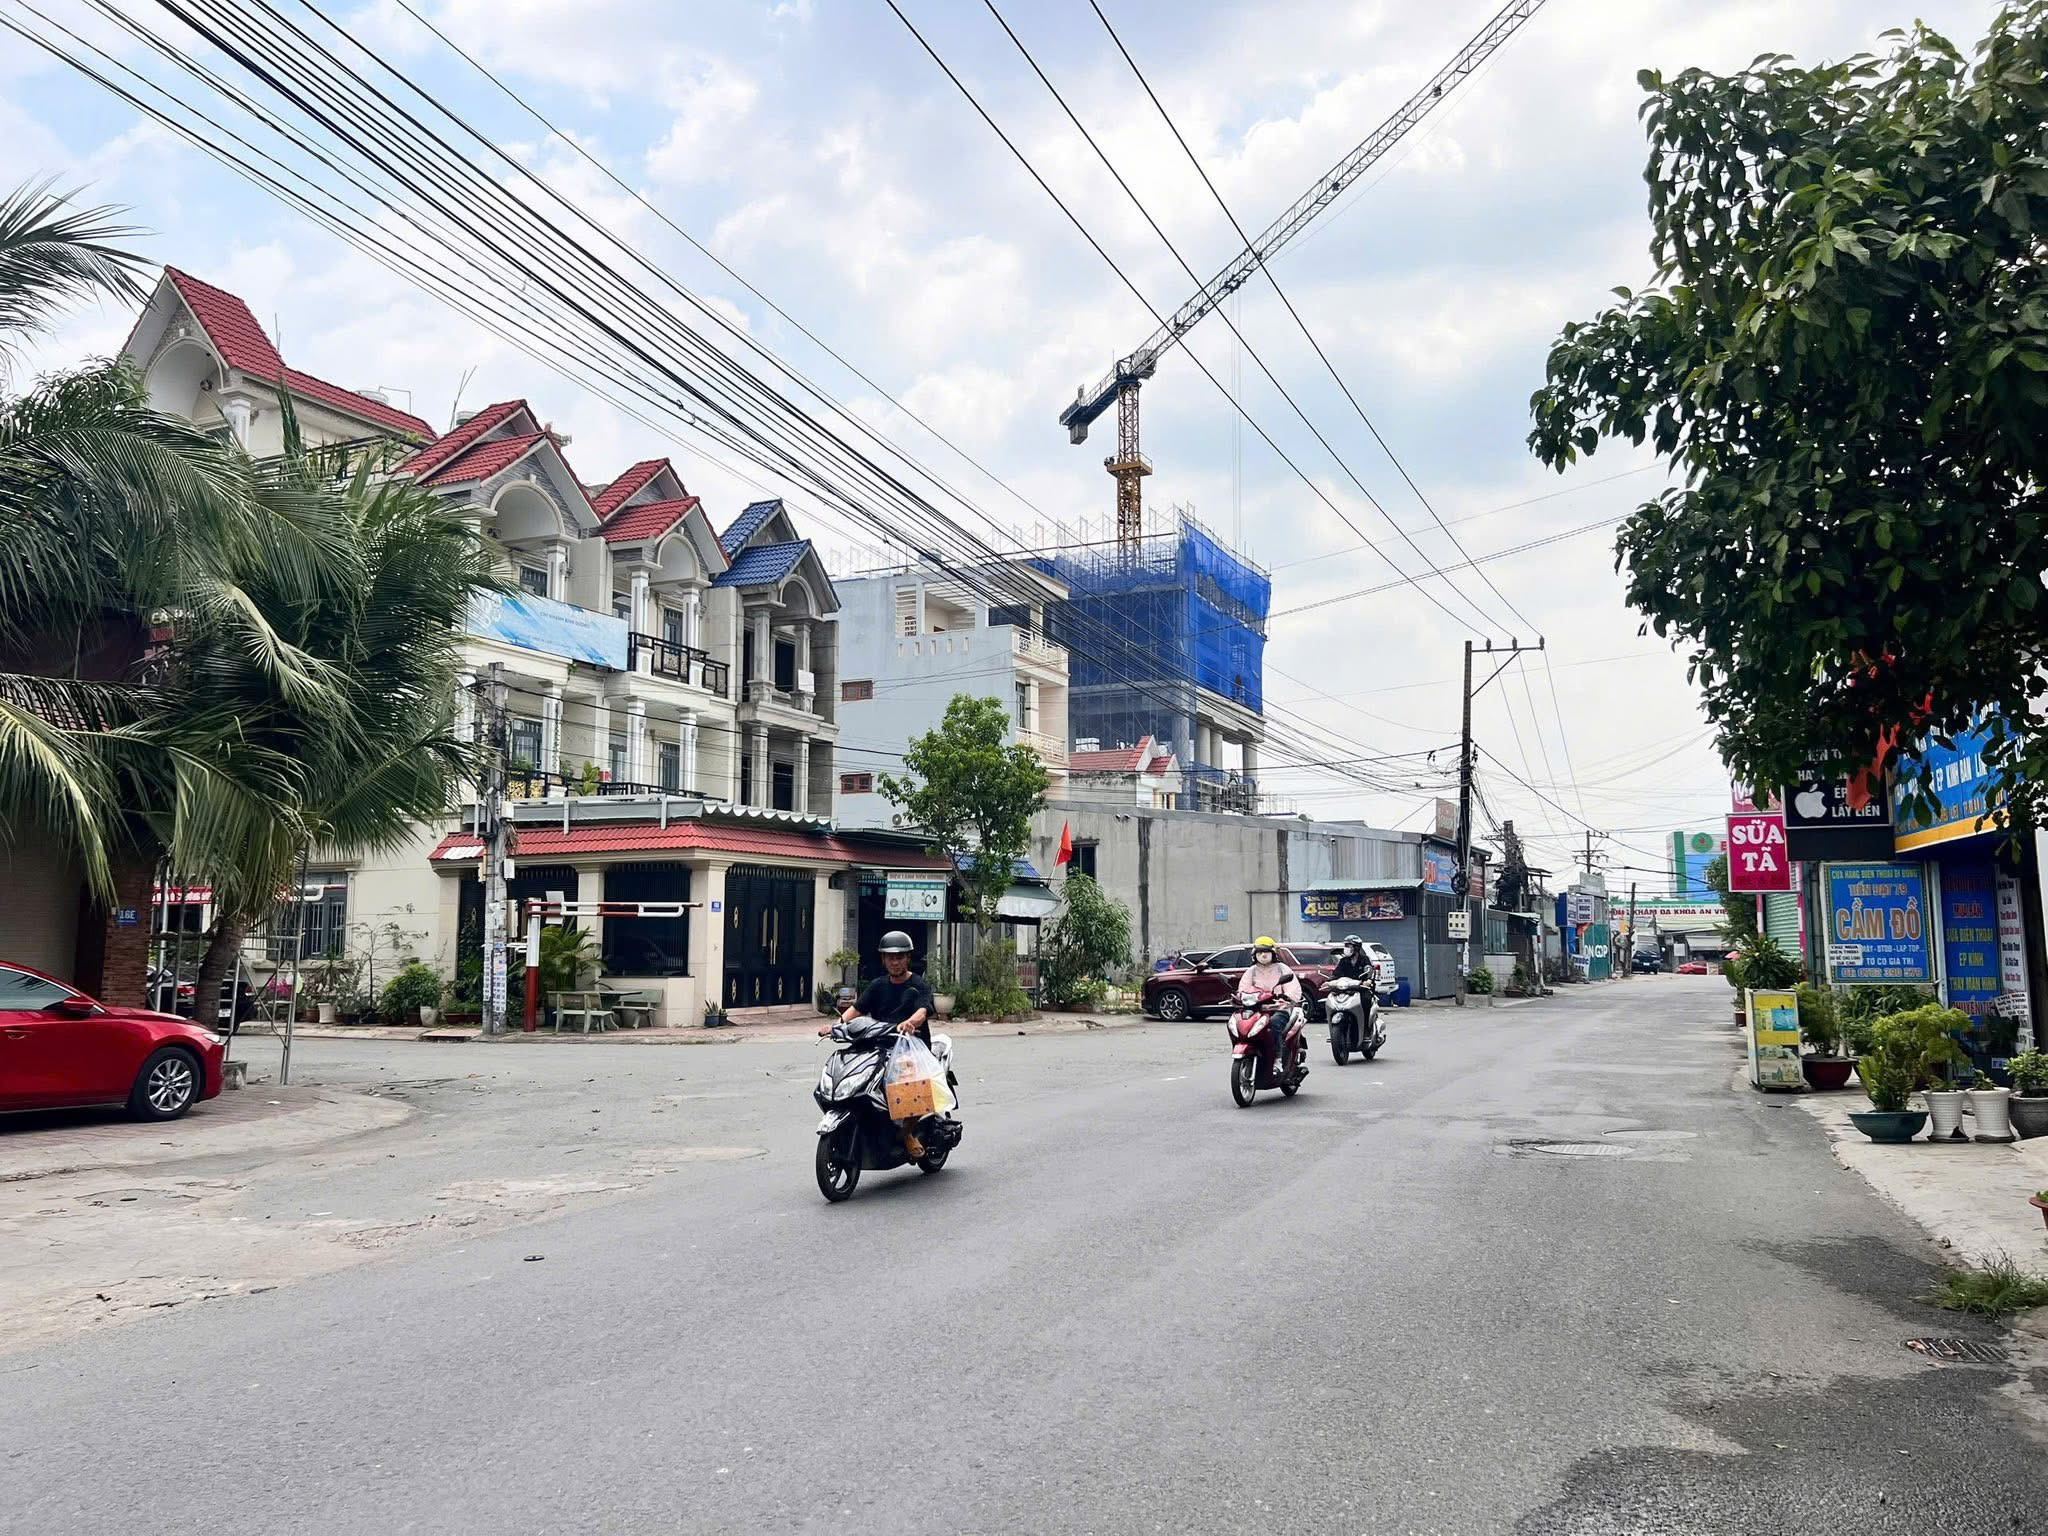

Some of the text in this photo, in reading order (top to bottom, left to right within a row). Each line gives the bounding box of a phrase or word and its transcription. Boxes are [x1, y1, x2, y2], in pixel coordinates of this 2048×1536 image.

[1731, 819, 1785, 845] SỮA
[1741, 846, 1778, 872] TÃ
[1303, 902, 1338, 916] 4 LON
[1835, 896, 1922, 940] CẦM ĐỒ
